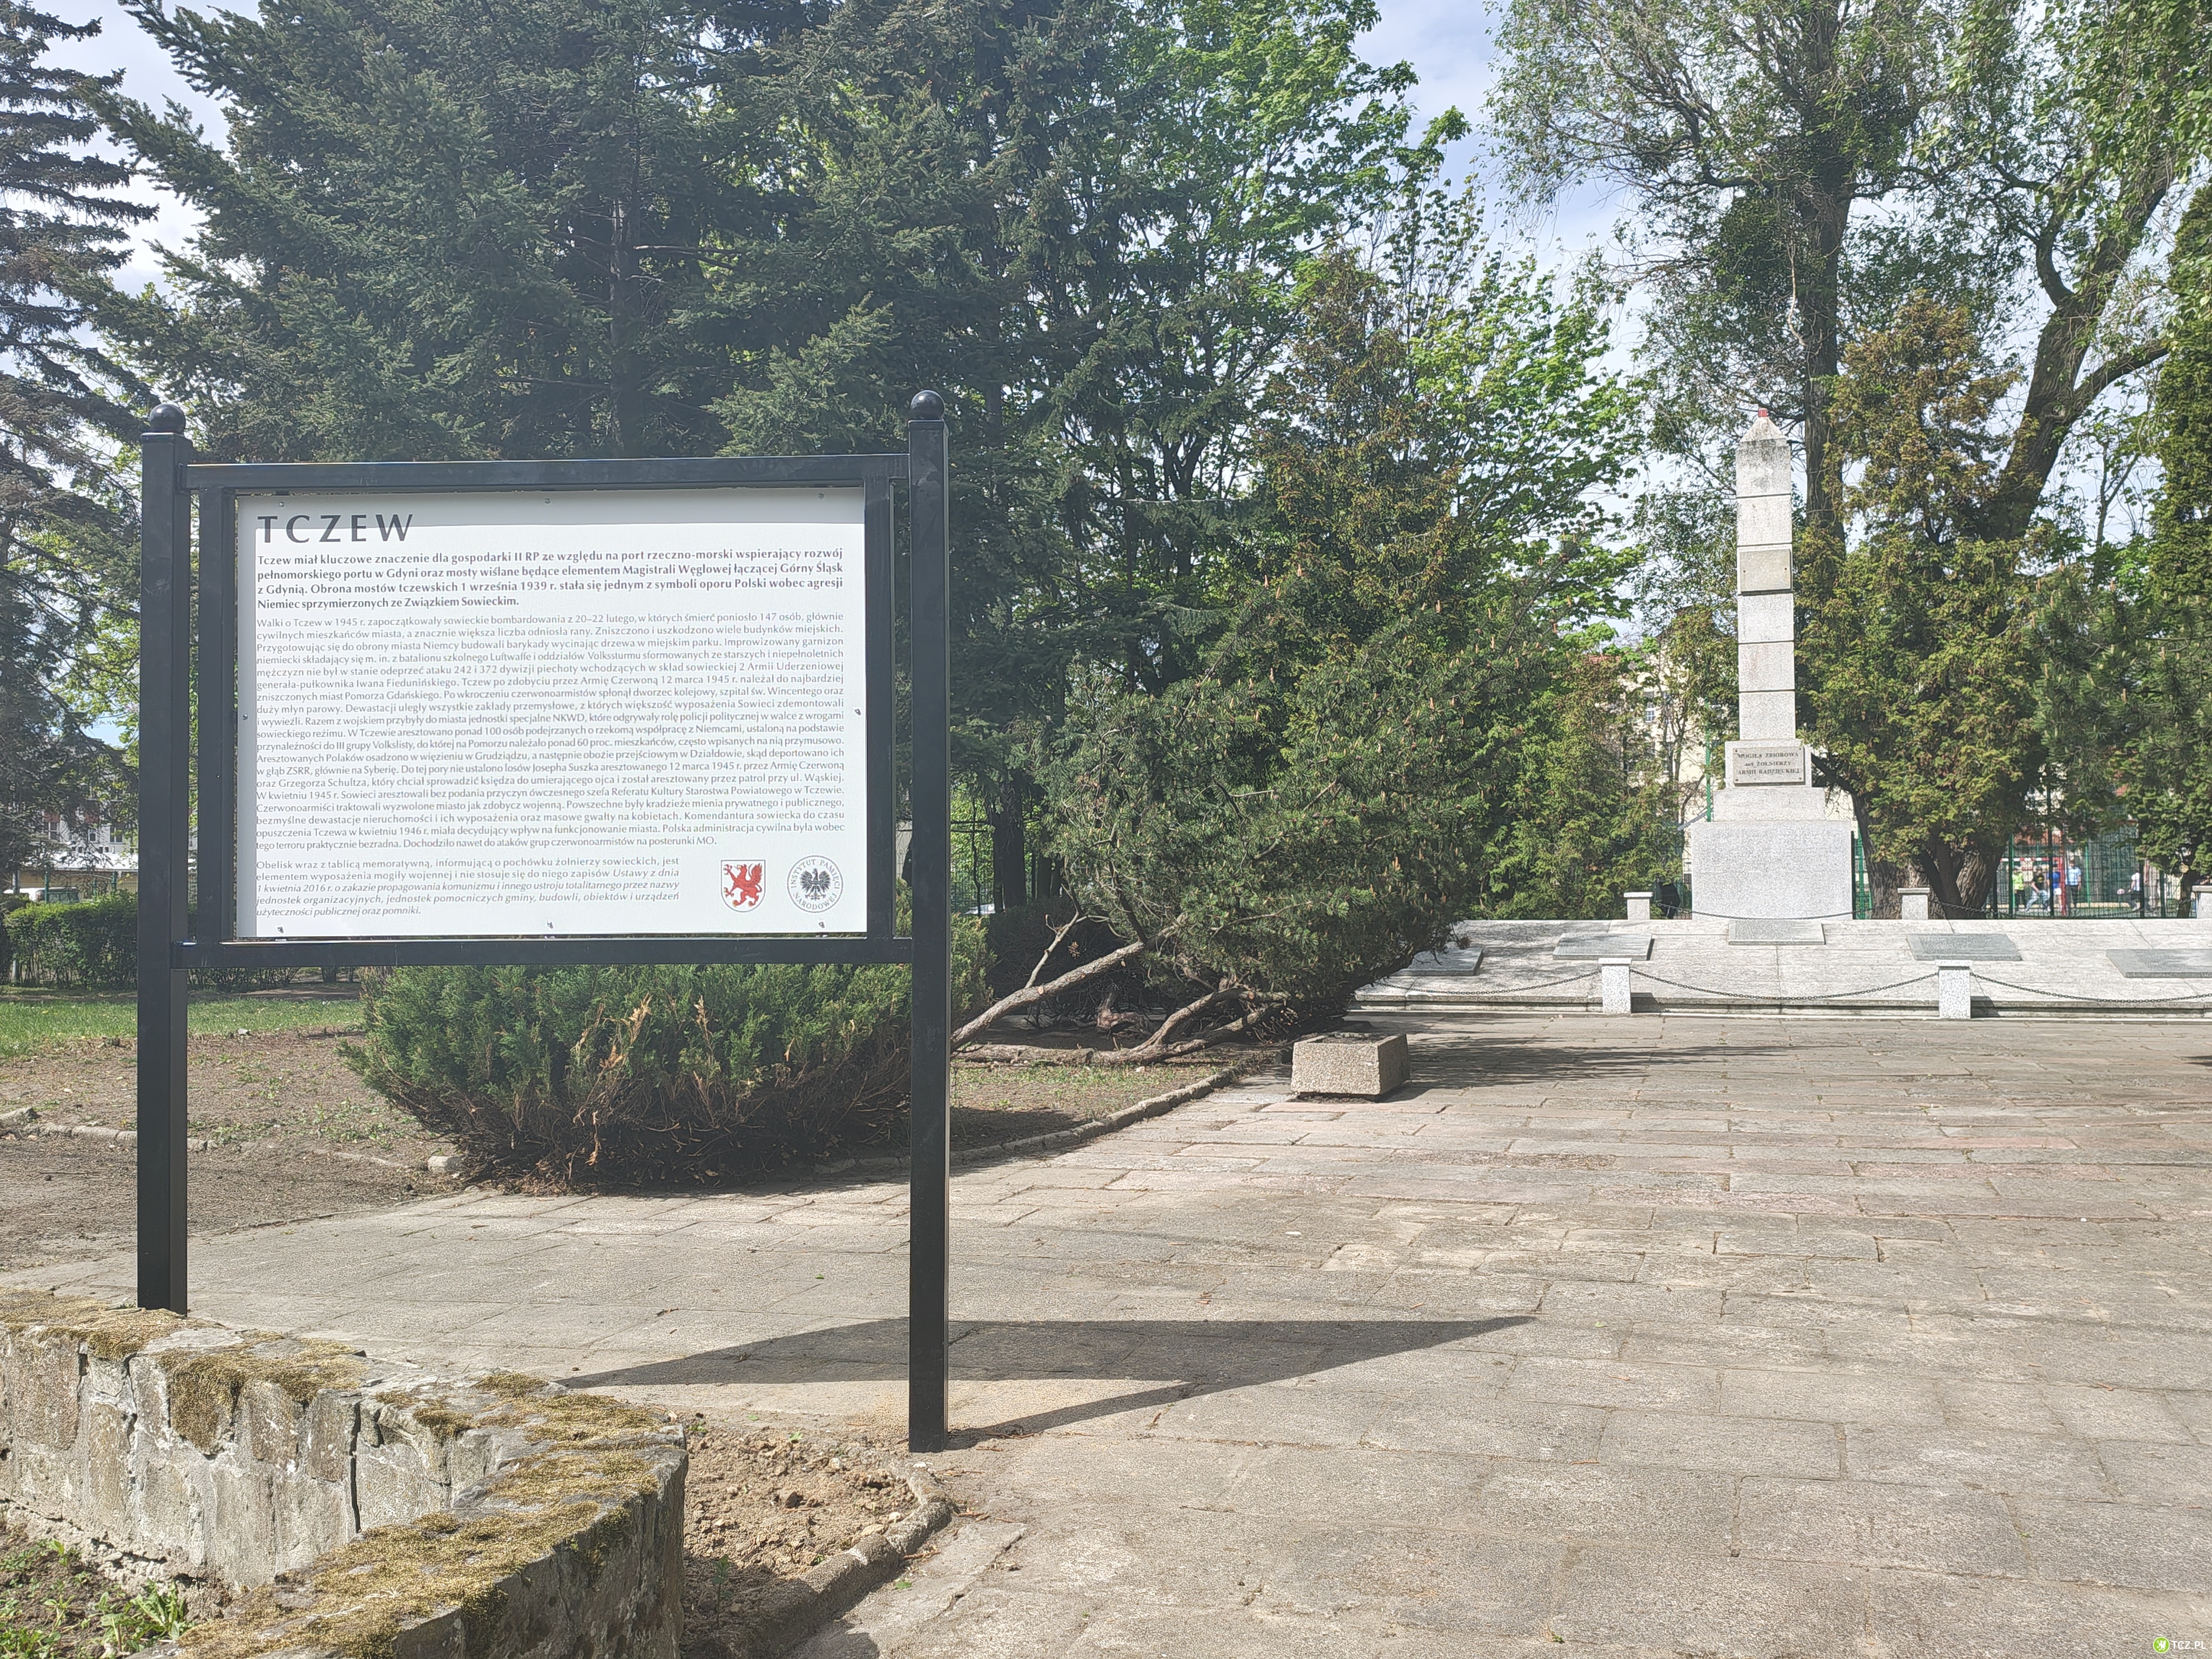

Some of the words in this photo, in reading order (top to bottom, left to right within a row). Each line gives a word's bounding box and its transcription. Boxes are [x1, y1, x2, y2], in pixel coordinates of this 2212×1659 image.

[257, 513, 413, 543] TCZEW
[258, 555, 292, 564] Tczew
[294, 554, 318, 564] miał
[320, 554, 372, 564] kluczowe
[374, 553, 430, 563] znaczenie
[432, 552, 449, 562] dla
[451, 551, 511, 564] gospodarki
[514, 552, 522, 561] II
[525, 551, 540, 561] RP
[556, 550, 603, 563] względu
[621, 551, 644, 562] port
[647, 549, 733, 559] rzeczno-morski
[736, 549, 801, 561] wspierający
[804, 548, 842, 560] rozwój
[258, 568, 342, 582] pełnomorskiego
[343, 569, 372, 581] portu
[374, 570, 384, 578] w
[386, 567, 419, 580] Gdyni
[446, 568, 478, 579] mosty
[480, 566, 520, 576] wiślane
[522, 565, 560, 578] będące
[562, 565, 621, 575] elementem
[622, 564, 676, 577] Magistrali
[678, 563, 732, 576] Węglowej
[733, 563, 778, 576] łączącej
[780, 563, 814, 575] Górny
[816, 561, 843, 575] Śląsk
[266, 583, 308, 596] Gdynią.
[310, 583, 352, 593] Obrona
[354, 583, 396, 592] mostów
[399, 582, 458, 592] tczewskich
[461, 582, 466, 591] 1
[469, 581, 517, 591] września
[520, 581, 547, 590] 1939
[559, 579, 584, 590] stała
[586, 580, 602, 592] się
[604, 579, 644, 591] jednym
[655, 578, 697, 591] symboli
[699, 580, 732, 590] oporu
[734, 577, 766, 588] Polski
[768, 577, 805, 587] wobec
[807, 577, 843, 589] agresji
[258, 598, 300, 608] Niemiec
[301, 597, 389, 610] sprzymierzonych
[404, 596, 460, 609] Związkiem
[461, 595, 520, 605] Sowieckim.
[257, 630, 305, 642] cywilnych
[306, 629, 370, 638] mieszkańców
[372, 629, 405, 639] miasta,
[414, 629, 456, 637] znacznie
[457, 628, 495, 639] większa
[497, 627, 526, 636] liczba
[528, 626, 568, 636] odniosła
[570, 628, 593, 637] rany.
[595, 626, 650, 635] Zniszczono
[652, 626, 655, 634] i
[657, 625, 714, 634] uszkodzono
[716, 624, 742, 633] wiele
[743, 624, 793, 635] budynków
[795, 623, 844, 635] miejskich.
[257, 643, 326, 654] Przygotowując
[327, 642, 340, 653] się
[342, 642, 354, 650] do
[355, 641, 389, 653] obrony
[391, 641, 421, 650] miasta
[423, 640, 459, 652] Niemcy
[461, 639, 504, 649] budowali
[507, 639, 550, 651] barykady
[551, 639, 599, 650] wycinając
[601, 638, 635, 647] drzewa
[648, 638, 690, 649] miejskim
[692, 637, 722, 649] parku.
[724, 637, 800, 648] Improwizowany
[802, 637, 844, 648] garnizon
[257, 691, 318, 703] zniszczonych
[319, 691, 343, 700] miast
[345, 691, 385, 699] Pomorza
[443, 690, 456, 698] Po
[456, 689, 509, 698] wkroczeniu
[511, 688, 597, 697] czerwonoarmistów
[598, 687, 632, 699] spłonął
[633, 687, 672, 696] dworzec
[674, 686, 718, 698] kolejowy,
[719, 686, 749, 697] szpital
[751, 686, 766, 694] św.
[767, 686, 822, 697] Wincentego
[255, 753, 325, 765] Aresztowanych
[326, 752, 365, 761] Polaków
[365, 752, 409, 761] osadzono
[419, 752, 464, 763] więzieniu
[539, 750, 582, 761] następnie
[583, 750, 615, 758] obozie
[616, 750, 678, 760] przejściowym
[746, 748, 767, 759] skąd
[768, 747, 829, 759] deportowano
[830, 747, 845, 756] ich
[255, 791, 267, 799] W
[268, 790, 307, 799] kwietniu
[309, 790, 332, 798] 1945
[341, 790, 376, 798] Sowieci
[377, 788, 429, 798] aresztowali
[430, 788, 447, 797] bez
[448, 788, 485, 799] podania
[486, 790, 528, 799] przyczyn
[529, 787, 585, 799] ówczesnego
[586, 787, 610, 795] szefa
[611, 786, 649, 795] Referatu
[651, 786, 684, 798] Kultury
[685, 786, 729, 795] Starostwa
[731, 786, 792, 797] Powiatowego
[804, 785, 845, 794] Tczewie.
[790, 859, 816, 888] INSTYTUT
[255, 895, 302, 907] jednostek
[303, 894, 384, 906] organizacyjnych,
[386, 893, 432, 905] jednostek
[433, 892, 503, 905] pomocniczych
[504, 893, 537, 903] gminy,
[539, 891, 581, 902] budowli,
[583, 891, 628, 900] obiektów
[630, 892, 633, 900] i
[635, 891, 679, 902] urządzeń
[793, 892, 837, 910] NARODOWEJ
[255, 907, 313, 918] użyteczności
[313, 906, 361, 918] publicznej
[382, 905, 421, 916] pomniki.
